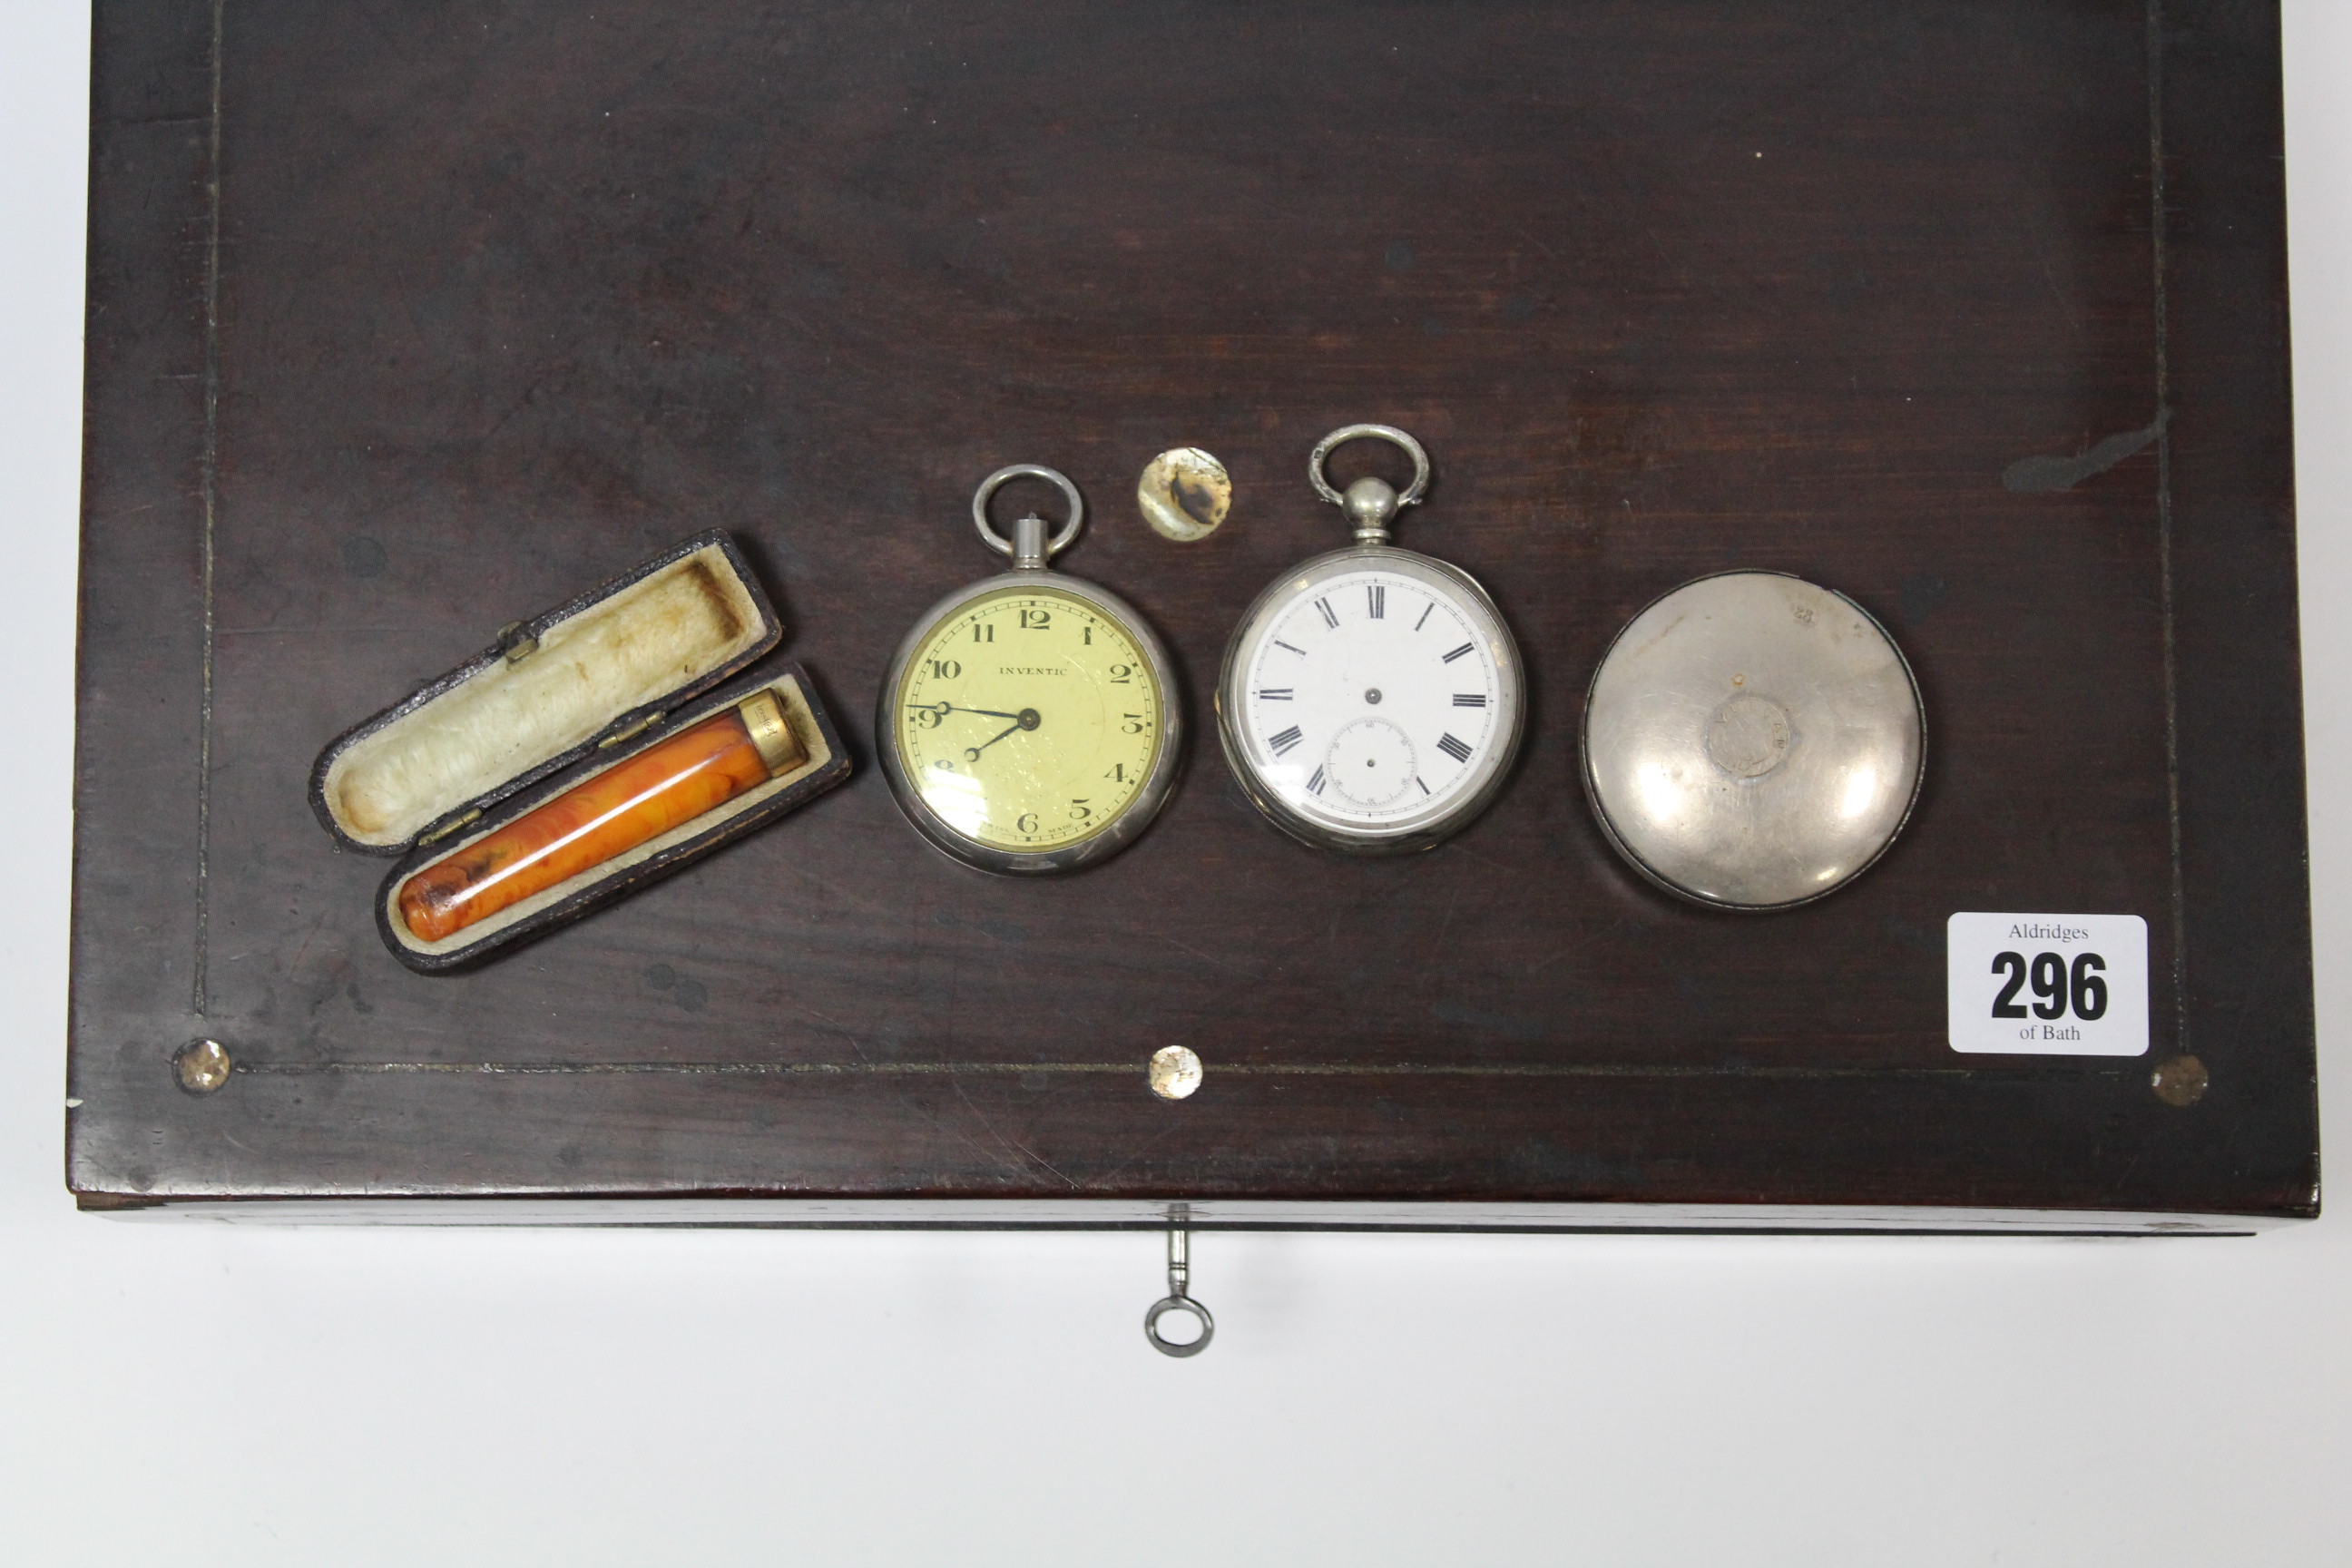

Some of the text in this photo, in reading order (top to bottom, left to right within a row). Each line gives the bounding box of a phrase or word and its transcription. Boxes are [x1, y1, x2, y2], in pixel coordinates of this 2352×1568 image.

[1017, 609, 1052, 630] 12
[971, 623, 995, 643] 11
[1083, 626, 1093, 645] 1
[930, 660, 962, 680] 10
[999, 667, 1068, 676] INVENTIC
[1110, 663, 1132, 683] 2
[918, 710, 943, 729] 9
[1122, 713, 1143, 734] 3
[1103, 763, 1129, 783] 4
[1069, 799, 1092, 819] 5
[1017, 813, 1039, 834] 6
[1047, 823, 1073, 833] MADE
[2008, 924, 2089, 943] Aldridges
[1991, 951, 2108, 1021] 296
[2019, 1024, 2081, 1041] of Bath
